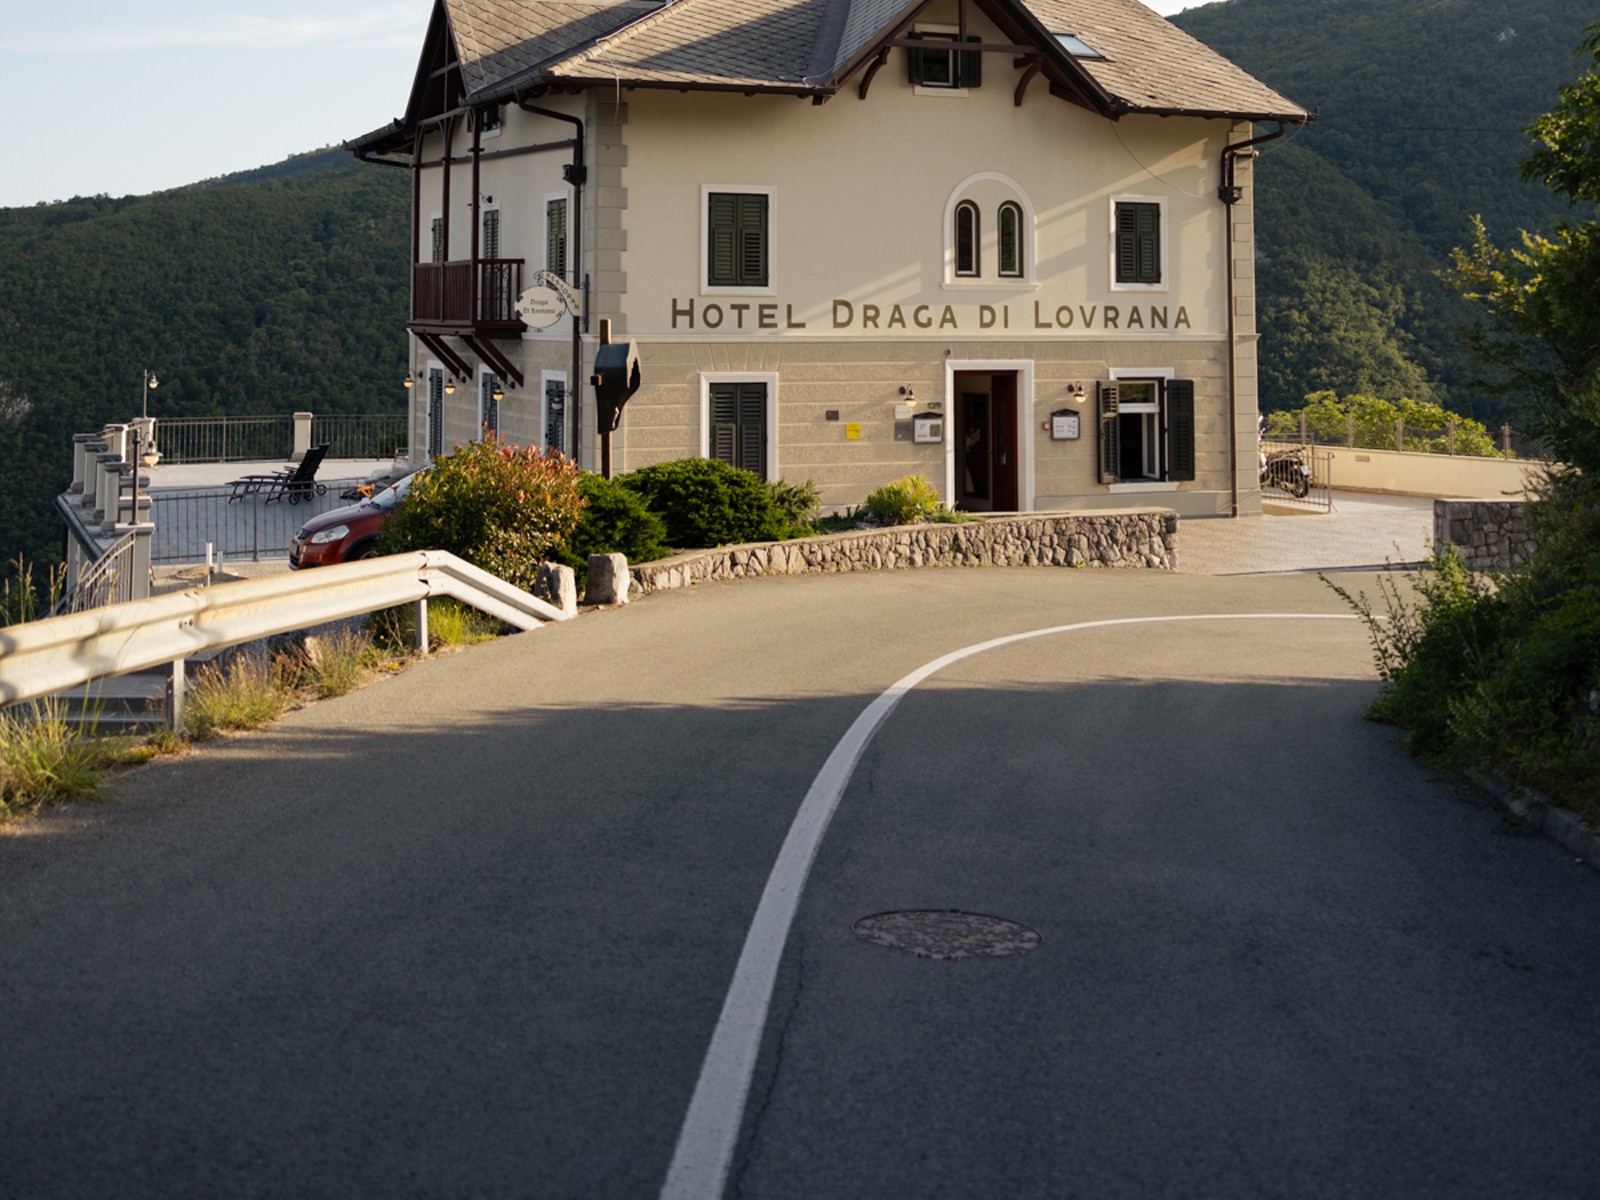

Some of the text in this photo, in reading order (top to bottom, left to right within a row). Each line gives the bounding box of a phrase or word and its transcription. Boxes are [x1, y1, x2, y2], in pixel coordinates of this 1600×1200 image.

[545, 272, 580, 310] RESTORAN
[671, 298, 1192, 329] HOTEL DRAGA DI LOVRANA
